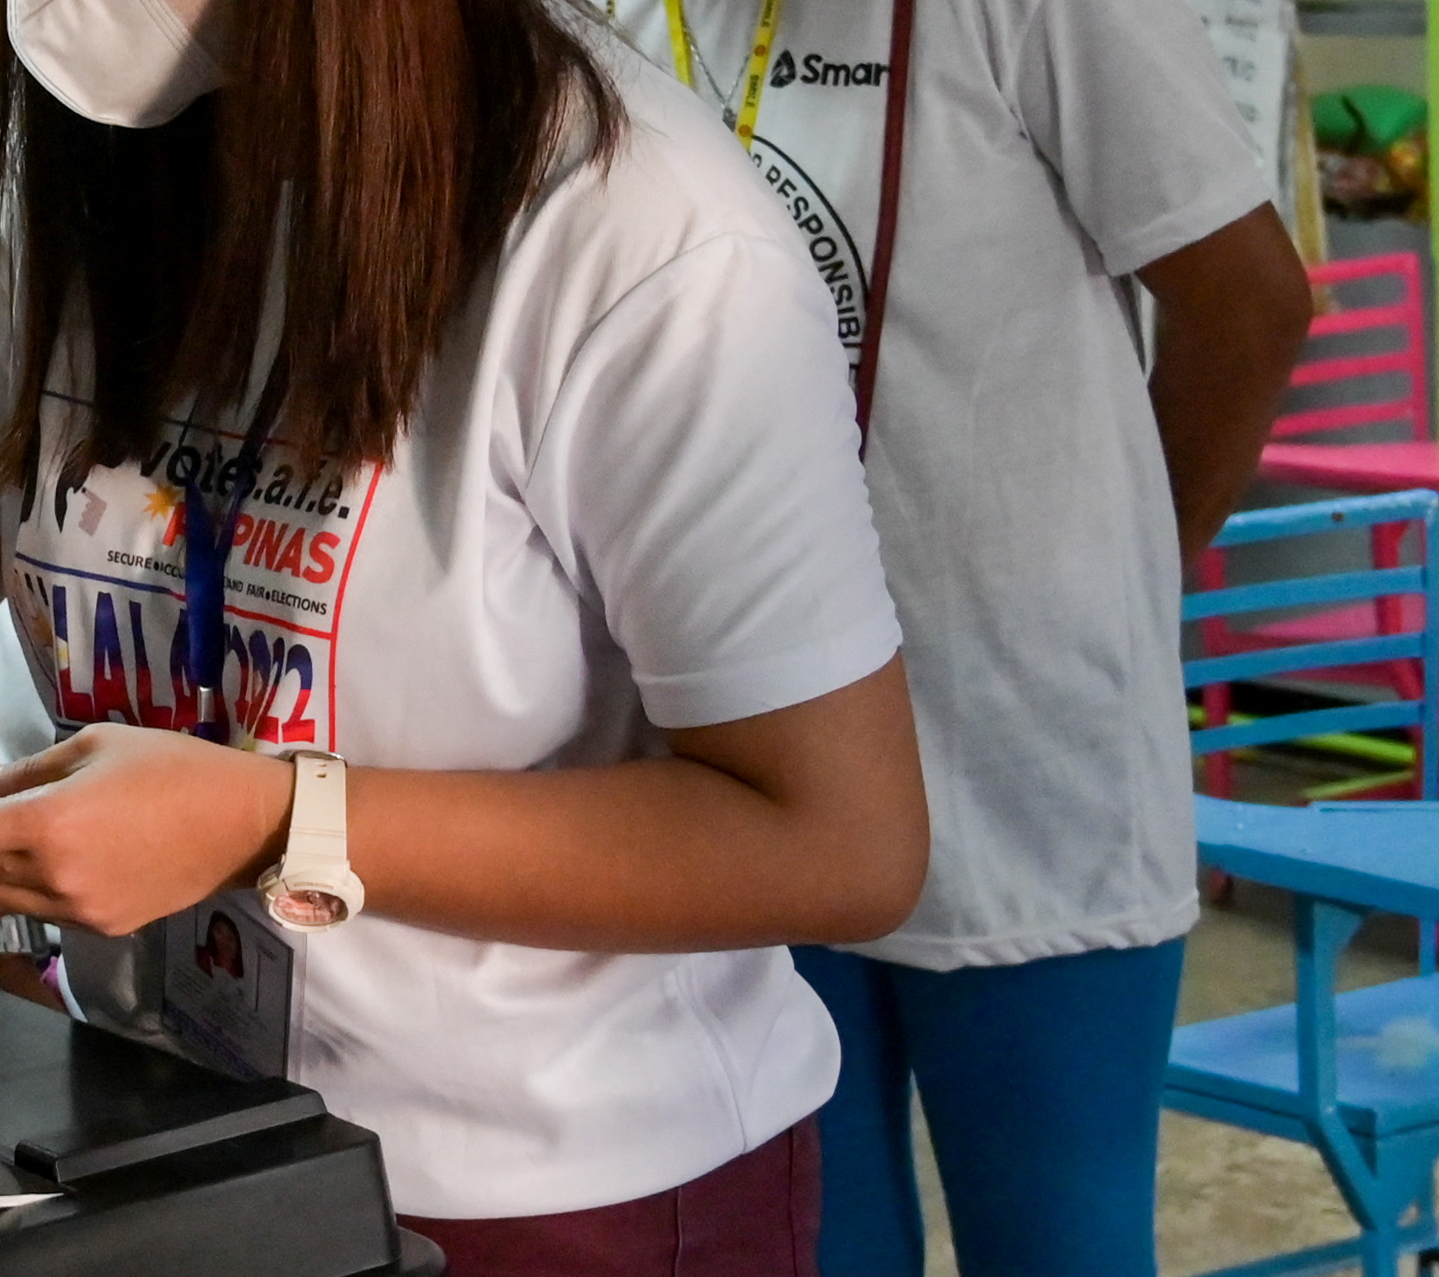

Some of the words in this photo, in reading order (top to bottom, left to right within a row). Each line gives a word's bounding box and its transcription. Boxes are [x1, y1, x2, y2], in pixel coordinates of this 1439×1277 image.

[801, 55, 893, 87] Smar
[107, 549, 152, 570] SECURE
[270, 590, 328, 616] ELECTIONS
